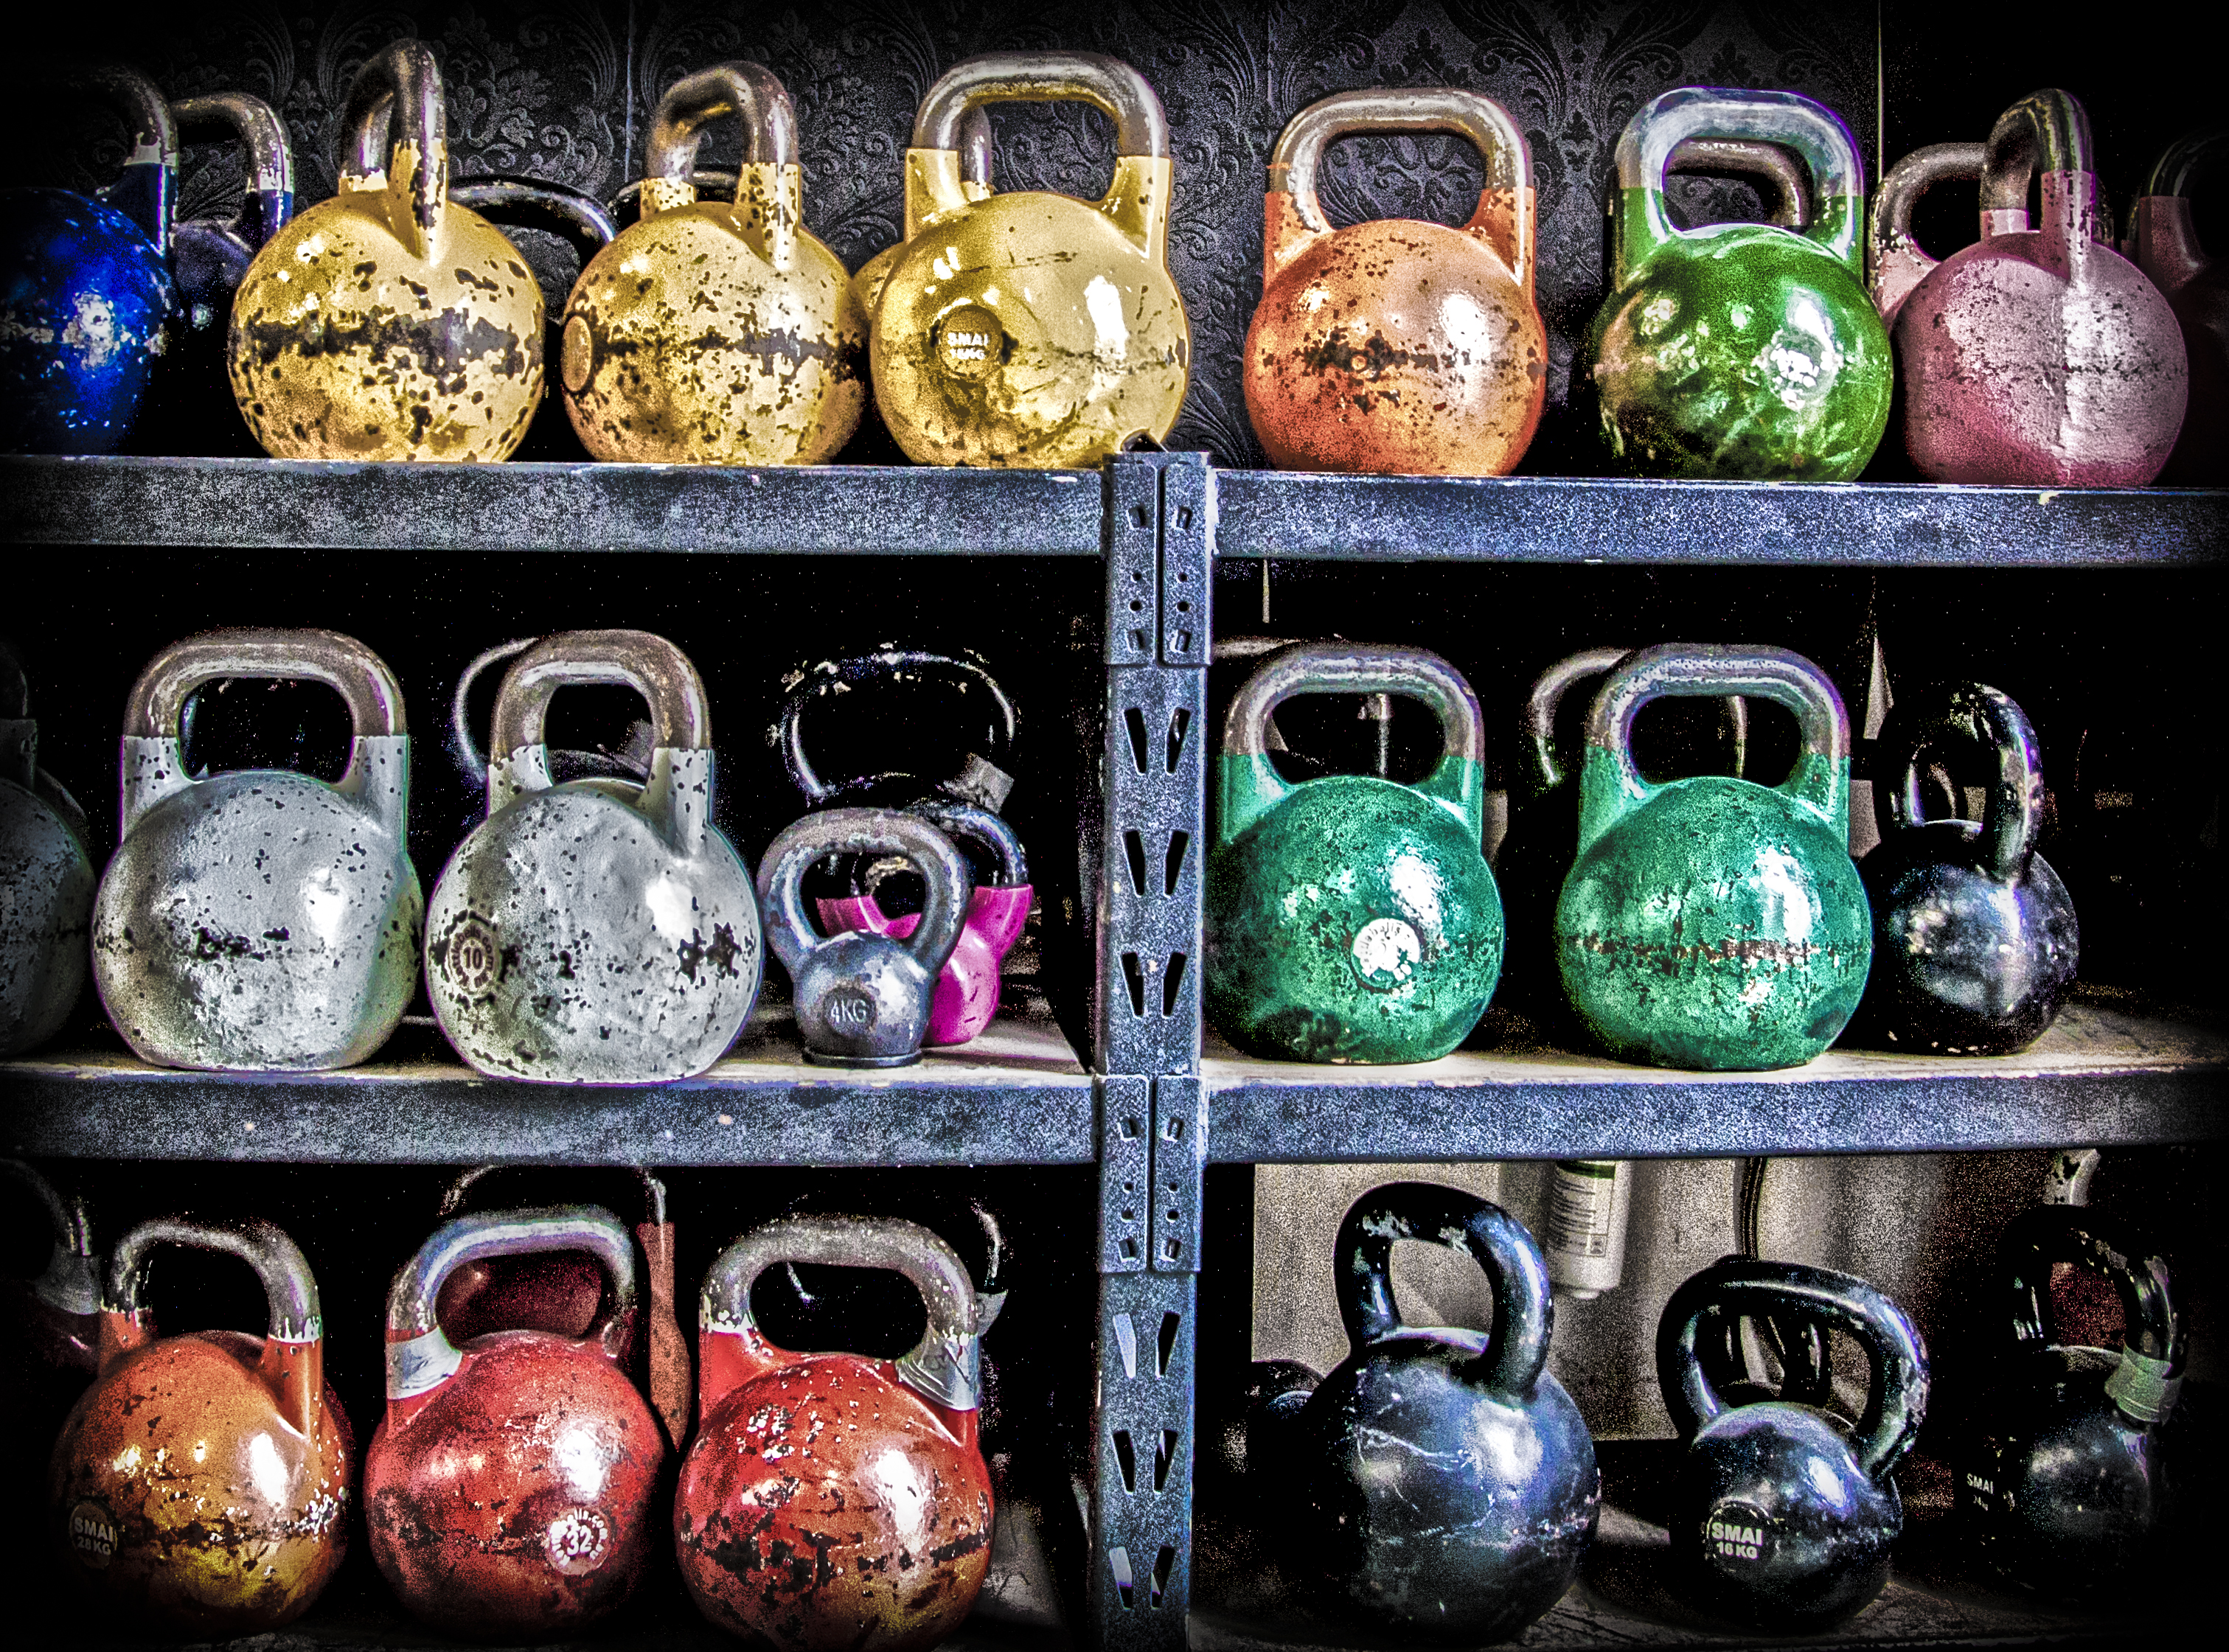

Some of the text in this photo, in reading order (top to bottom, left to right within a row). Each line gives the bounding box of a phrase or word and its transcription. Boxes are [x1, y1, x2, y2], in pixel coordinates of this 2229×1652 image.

[947, 332, 989, 346] SMAI
[464, 947, 483, 969] 10
[831, 1000, 866, 1024] 4KG
[1966, 1472, 1994, 1495] SMAI
[74, 1517, 114, 1542] SMAI
[567, 1524, 591, 1555] 32
[1711, 1522, 1763, 1547] SMAI
